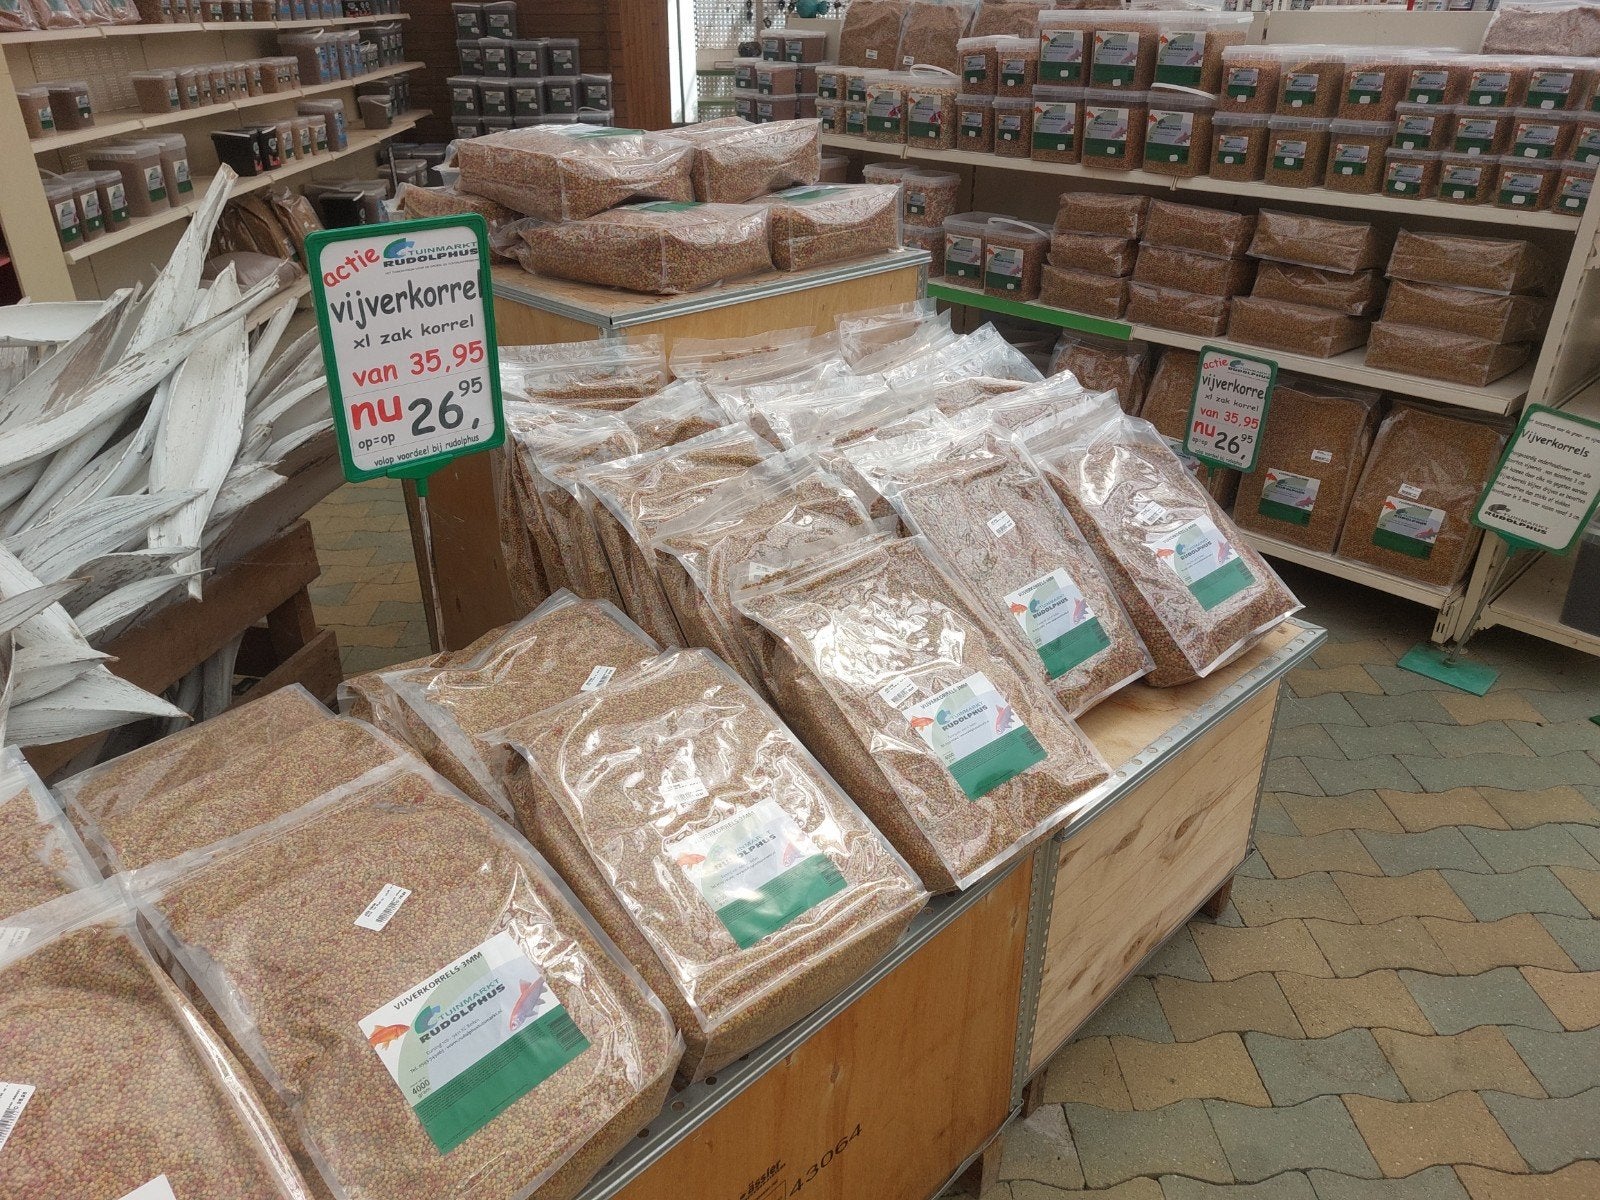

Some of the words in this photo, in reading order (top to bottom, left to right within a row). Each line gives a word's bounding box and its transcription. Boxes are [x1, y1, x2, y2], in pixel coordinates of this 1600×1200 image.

[383, 248, 479, 267] RUDOLPHUS
[408, 241, 477, 256] TUINMARKT
[323, 248, 380, 287] actie
[353, 334, 370, 349] xl
[381, 327, 413, 344] zak
[421, 314, 474, 337] korrel
[353, 364, 398, 387] van
[410, 340, 484, 376] 35,95
[1203, 358, 1228, 370] actie
[351, 396, 403, 430] nu
[1216, 395, 1230, 404] zak
[1233, 401, 1259, 412] korrel
[1193, 421, 1216, 438] nu
[1200, 407, 1219, 419] van
[1223, 411, 1259, 430] 35,95
[358, 433, 395, 450] op=op
[374, 457, 394, 466] volop
[397, 446, 430, 461] voordeel
[432, 443, 442, 453] bij
[445, 435, 479, 449] rudolphus
[1522, 429, 1590, 457] Vijverkorrels
[942, 704, 988, 731] RUDOLPHUS
[393, 966, 461, 1011] VIJVERKORRELS
[462, 951, 484, 969] 3MM
[439, 977, 500, 1020] TUINMARKT
[418, 983, 506, 1044] RUDOLPHUS
[412, 1079, 431, 1096] 4000
[789, 1122, 863, 1197] 43064
